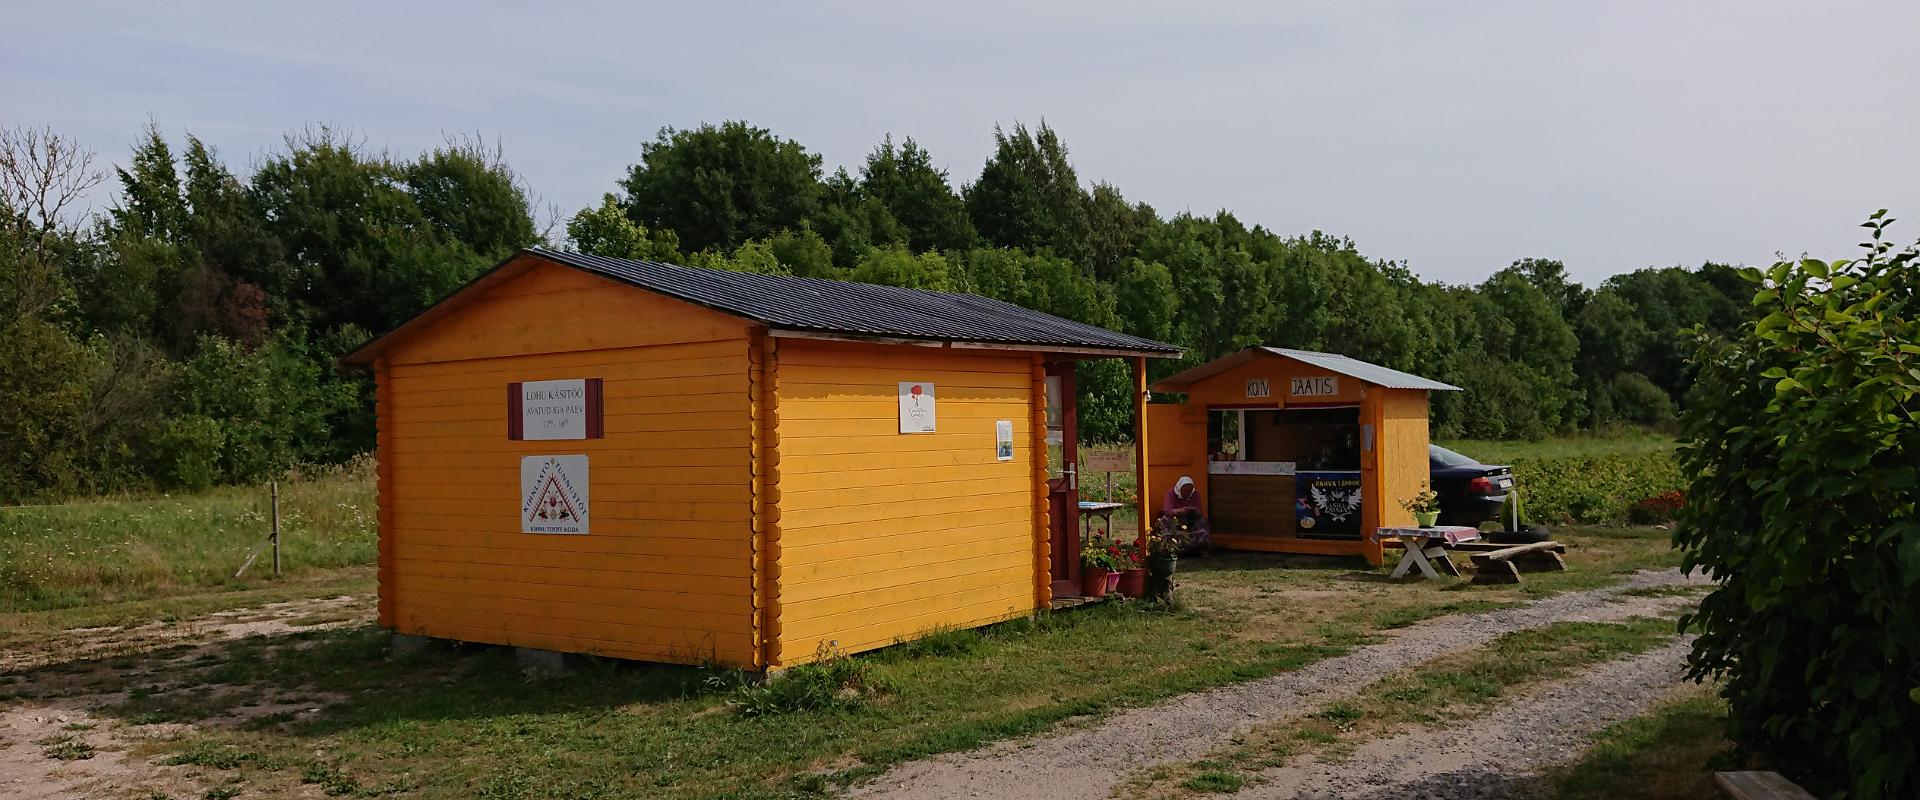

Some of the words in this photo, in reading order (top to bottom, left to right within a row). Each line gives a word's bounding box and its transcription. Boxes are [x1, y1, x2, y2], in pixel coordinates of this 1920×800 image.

[1247, 379, 1270, 397] KOHV
[1292, 378, 1333, 396] JAATIS
[526, 390, 547, 401] LOHU
[526, 406, 552, 416] AVATUD
[552, 406, 565, 415] IGA
[565, 404, 583, 415] PÄEV
